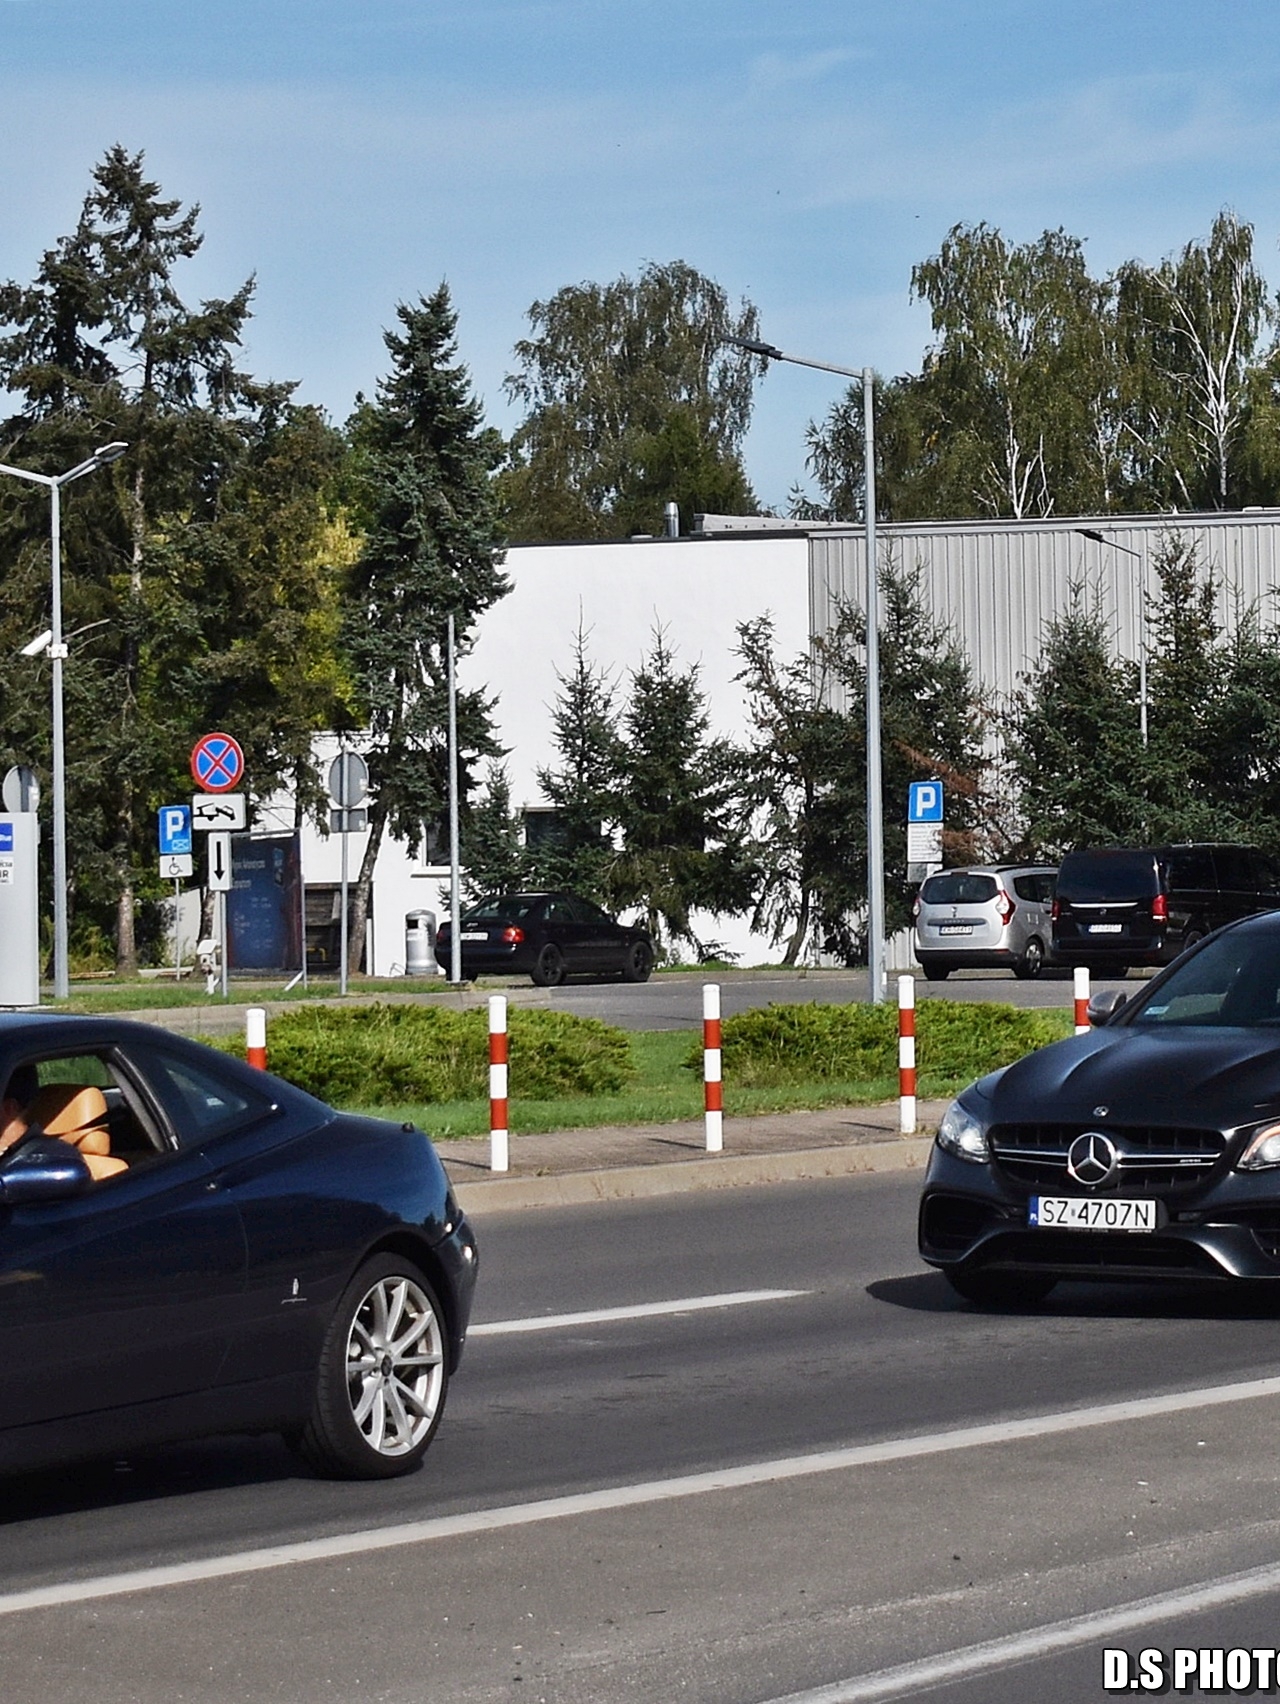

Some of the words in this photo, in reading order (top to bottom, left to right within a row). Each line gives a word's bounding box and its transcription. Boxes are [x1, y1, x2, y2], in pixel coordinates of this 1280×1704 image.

[915, 786, 936, 817] P
[166, 810, 184, 840] P
[1043, 1199, 1069, 1224] SZ
[1077, 1201, 1149, 1227] 4707N
